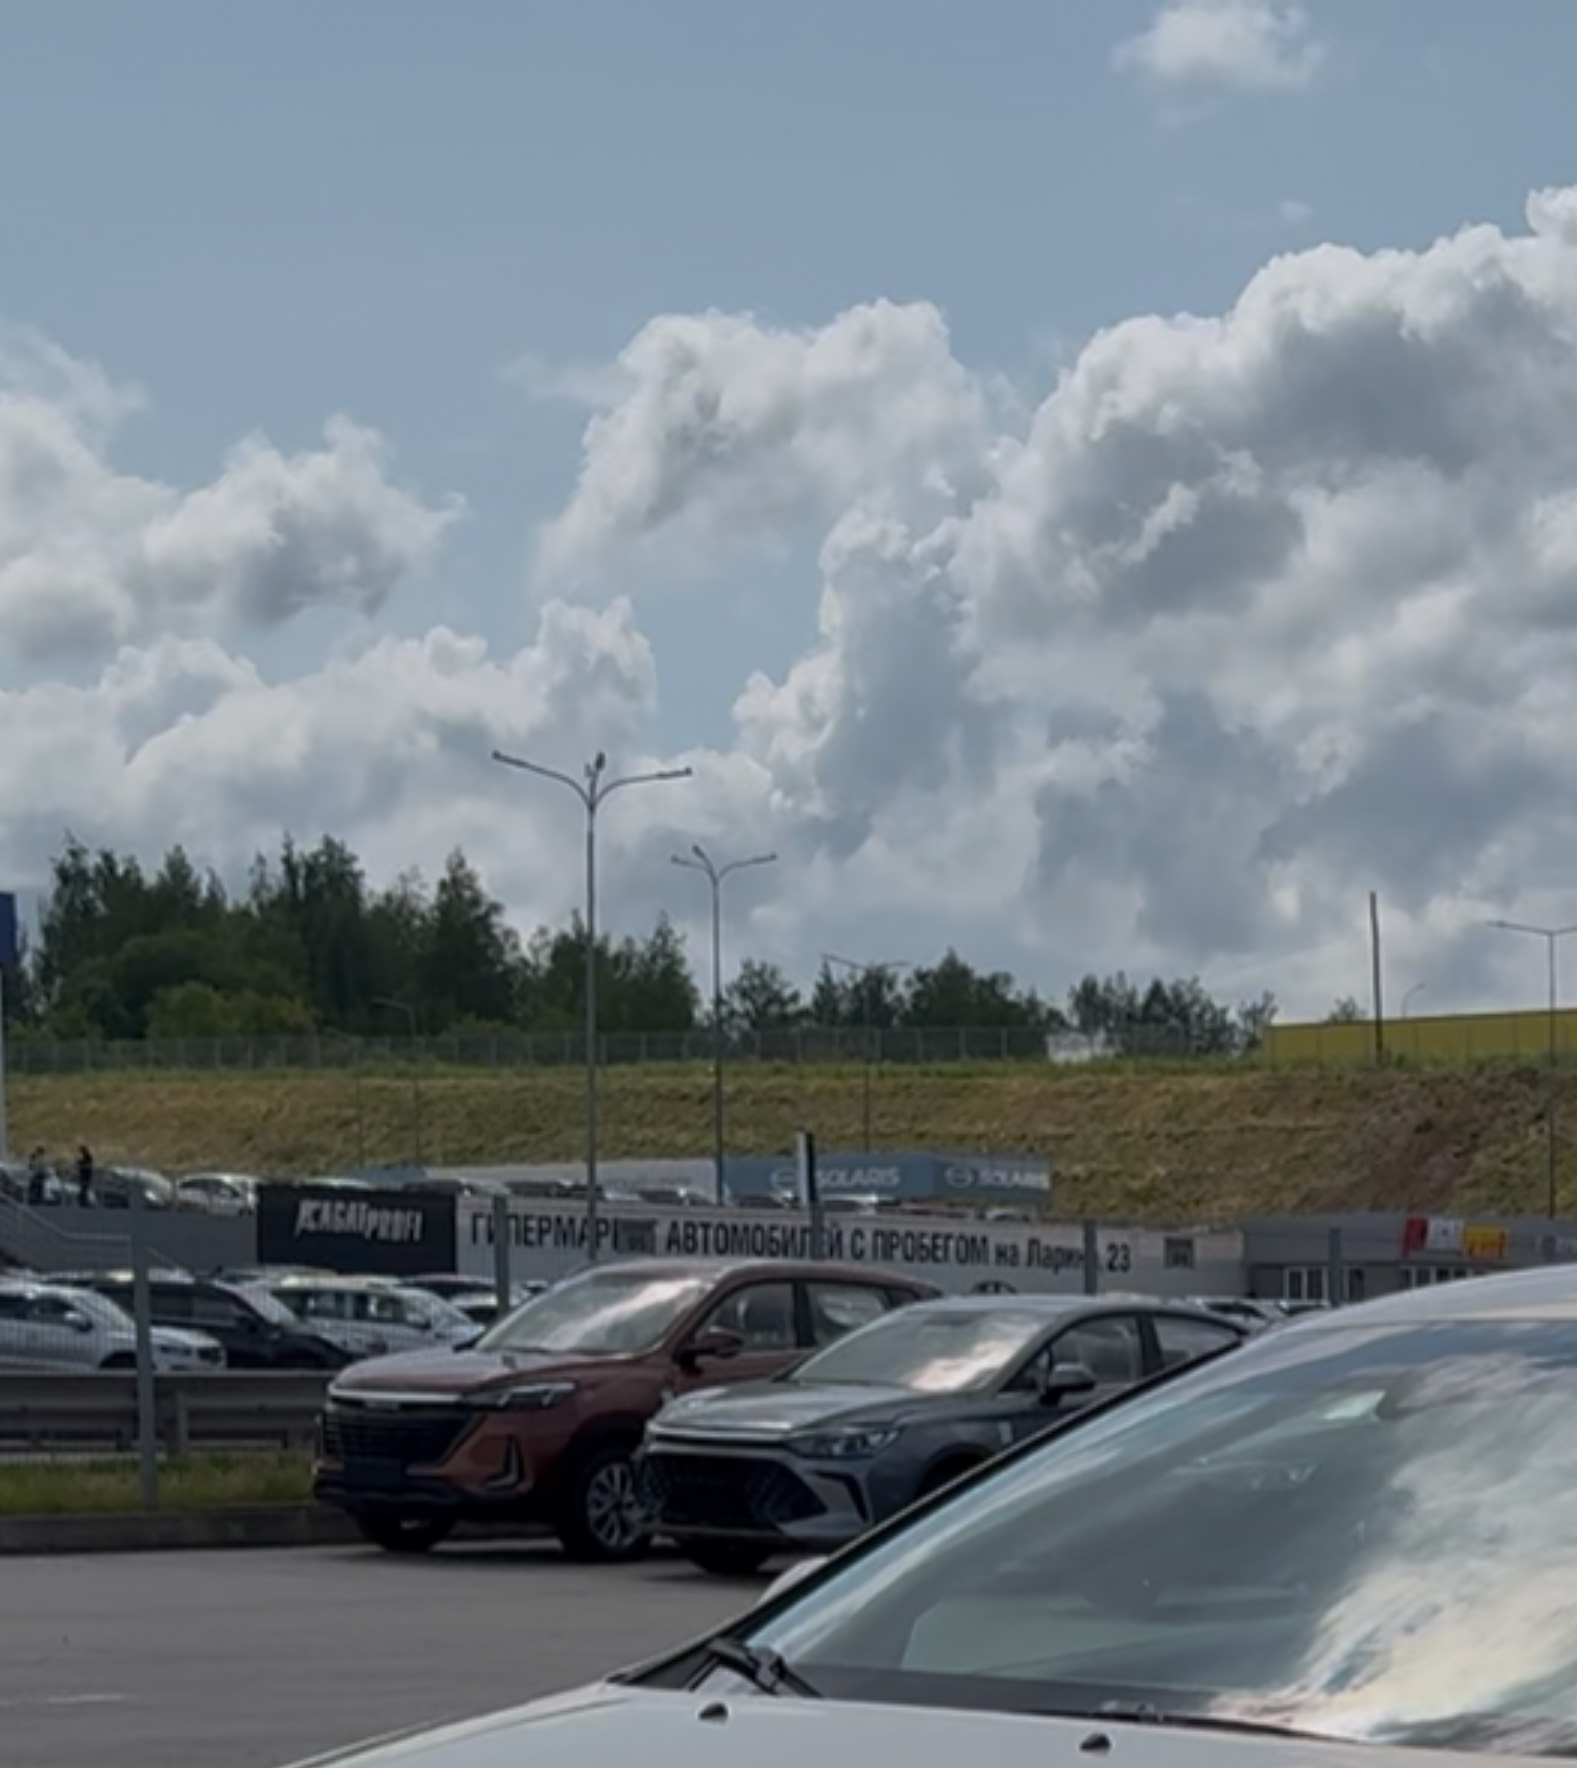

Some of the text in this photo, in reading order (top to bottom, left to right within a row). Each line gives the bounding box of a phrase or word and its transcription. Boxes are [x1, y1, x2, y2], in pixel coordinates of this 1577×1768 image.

[872, 1229, 988, 1267] ПРОБЕГОМ
[995, 1242, 1021, 1266] на
[1106, 1243, 1131, 1273] 23
